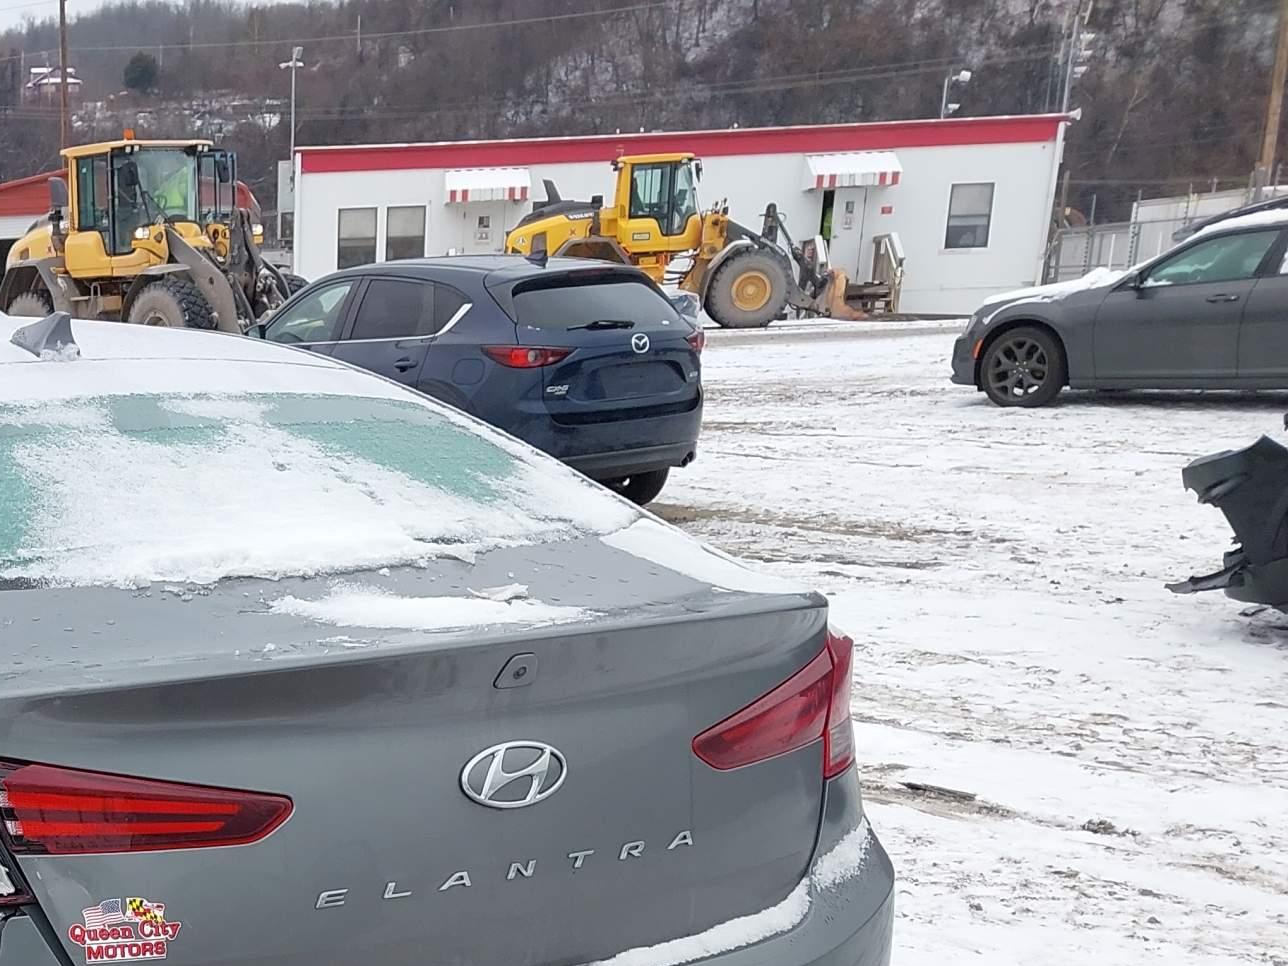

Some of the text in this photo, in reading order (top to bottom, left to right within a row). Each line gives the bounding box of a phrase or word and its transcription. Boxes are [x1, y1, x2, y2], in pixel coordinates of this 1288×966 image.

[315, 830, 695, 909] ELANTRA
[69, 919, 182, 946] Queen City
[86, 940, 166, 960] MOTORS
